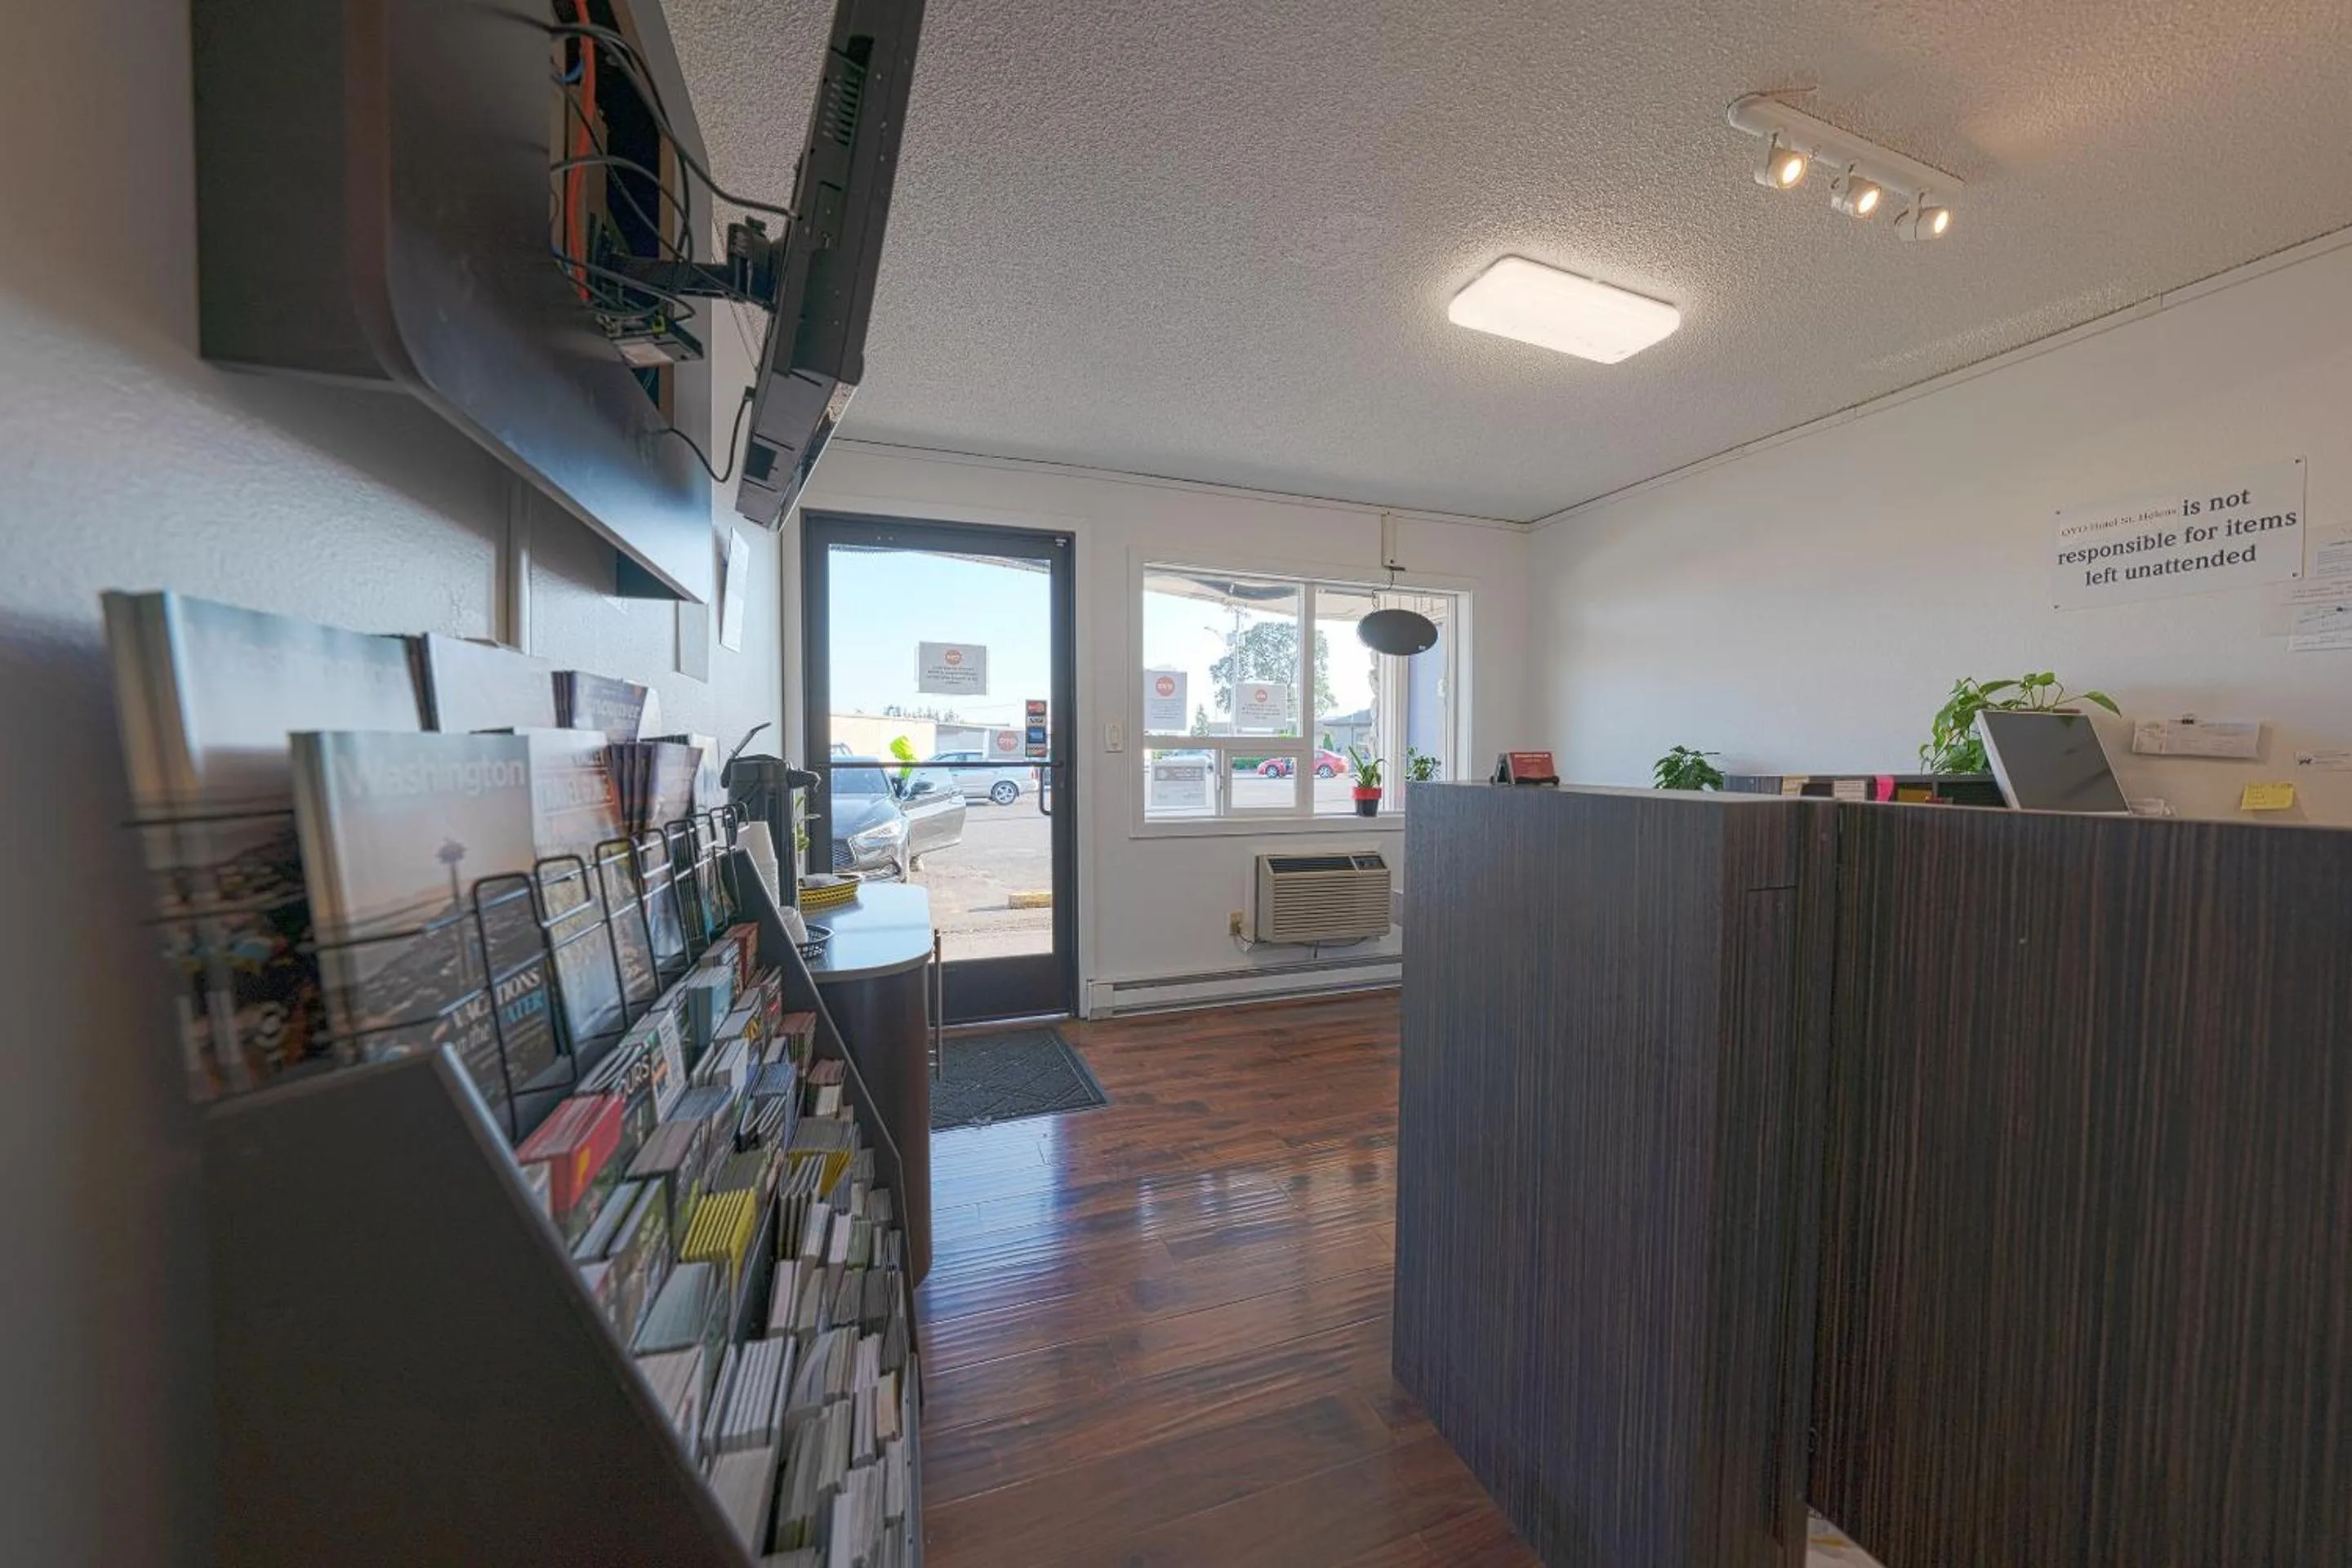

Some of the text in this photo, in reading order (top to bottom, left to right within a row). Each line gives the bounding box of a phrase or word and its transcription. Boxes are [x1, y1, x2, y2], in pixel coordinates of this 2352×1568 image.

[2181, 499, 2201, 517] is
[2209, 488, 2252, 512] not
[2057, 510, 2297, 566] responsible for items
[2084, 544, 2257, 587] left unattended
[338, 752, 527, 797] Washington
